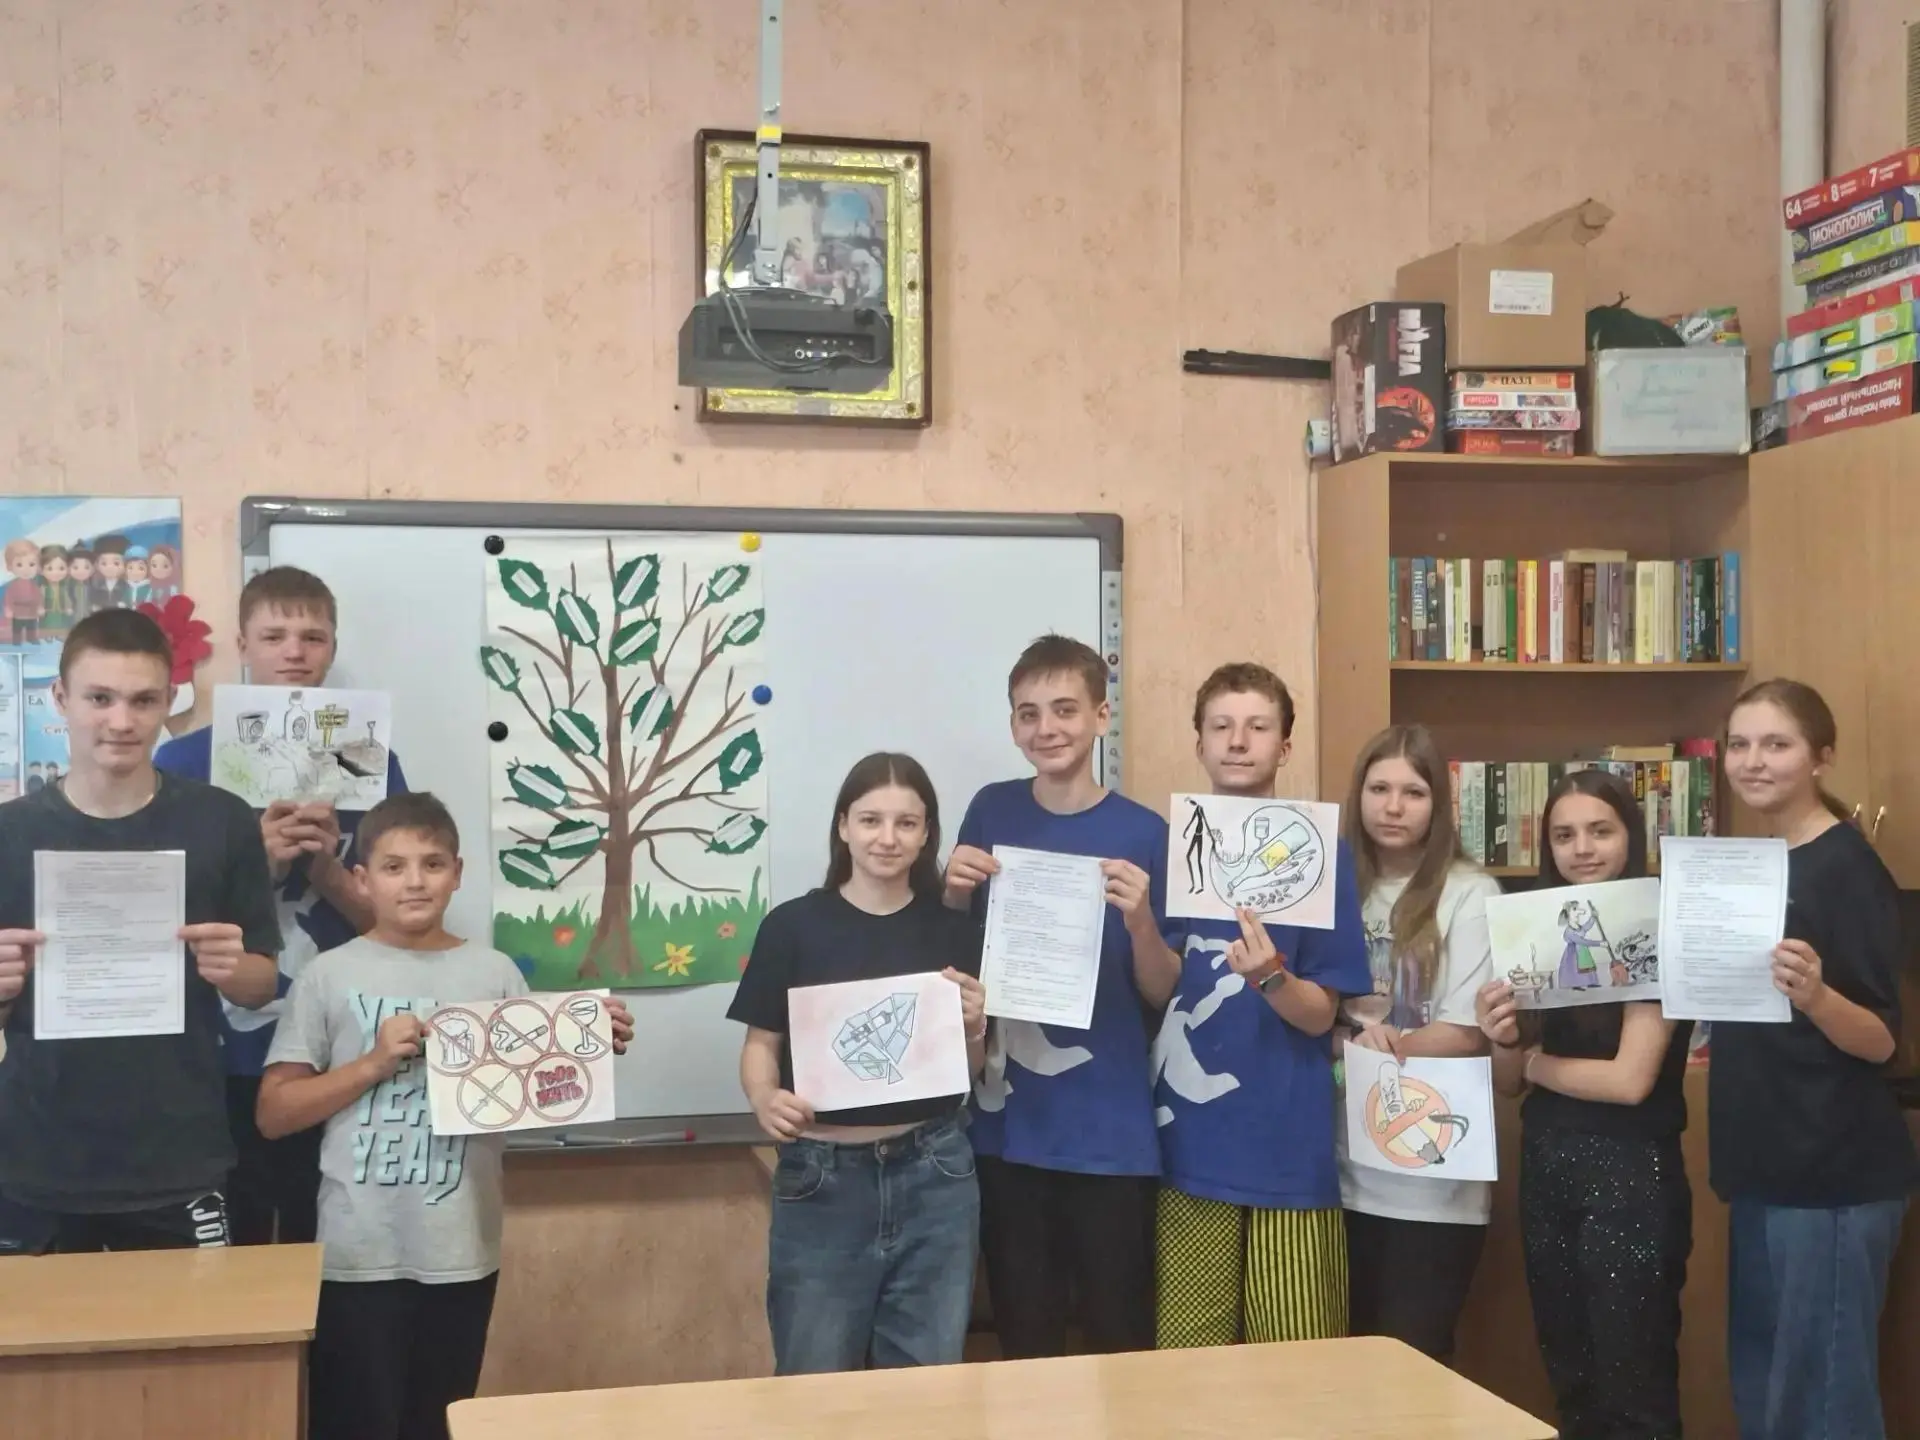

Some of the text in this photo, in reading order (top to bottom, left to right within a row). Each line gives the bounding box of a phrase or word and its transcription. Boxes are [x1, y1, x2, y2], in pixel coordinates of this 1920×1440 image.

[1786, 199, 1802, 219] 64
[1831, 183, 1840, 201] 8
[1869, 167, 1878, 188] 7
[1397, 307, 1431, 377] MAFIA
